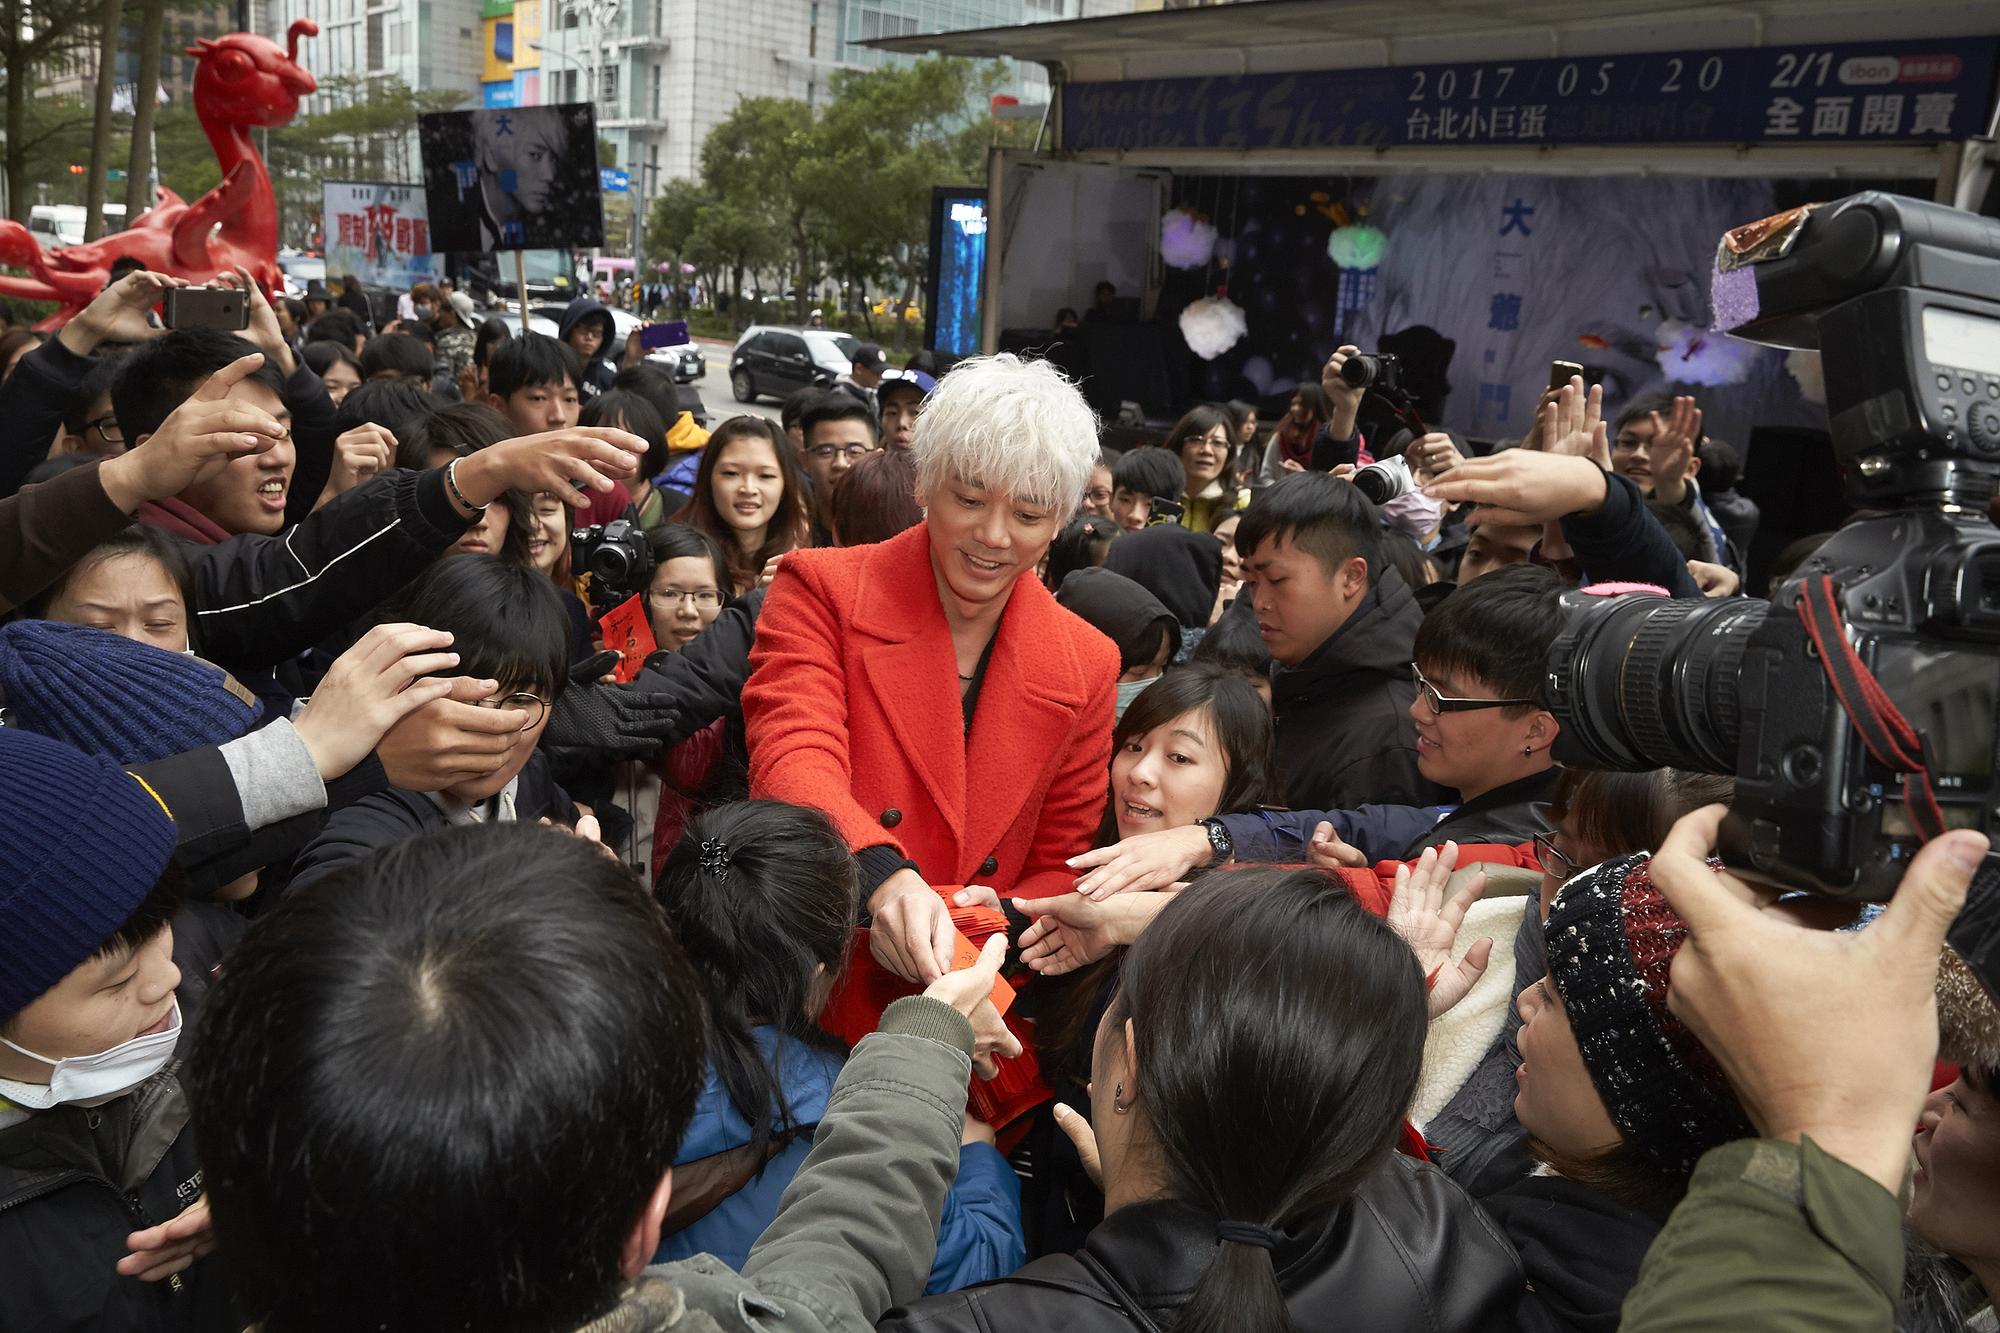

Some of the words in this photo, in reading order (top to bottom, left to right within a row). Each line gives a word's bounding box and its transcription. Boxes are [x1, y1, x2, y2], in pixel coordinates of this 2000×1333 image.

[1409, 66, 1515, 101] 2017
[1557, 62, 1615, 97] 05
[1660, 56, 1723, 92] 20
[1770, 52, 1834, 88] 2/1
[1848, 63, 1891, 79] ibon
[1406, 104, 1548, 140] 台北小巨蛋
[1764, 92, 1958, 135] 全面開賣
